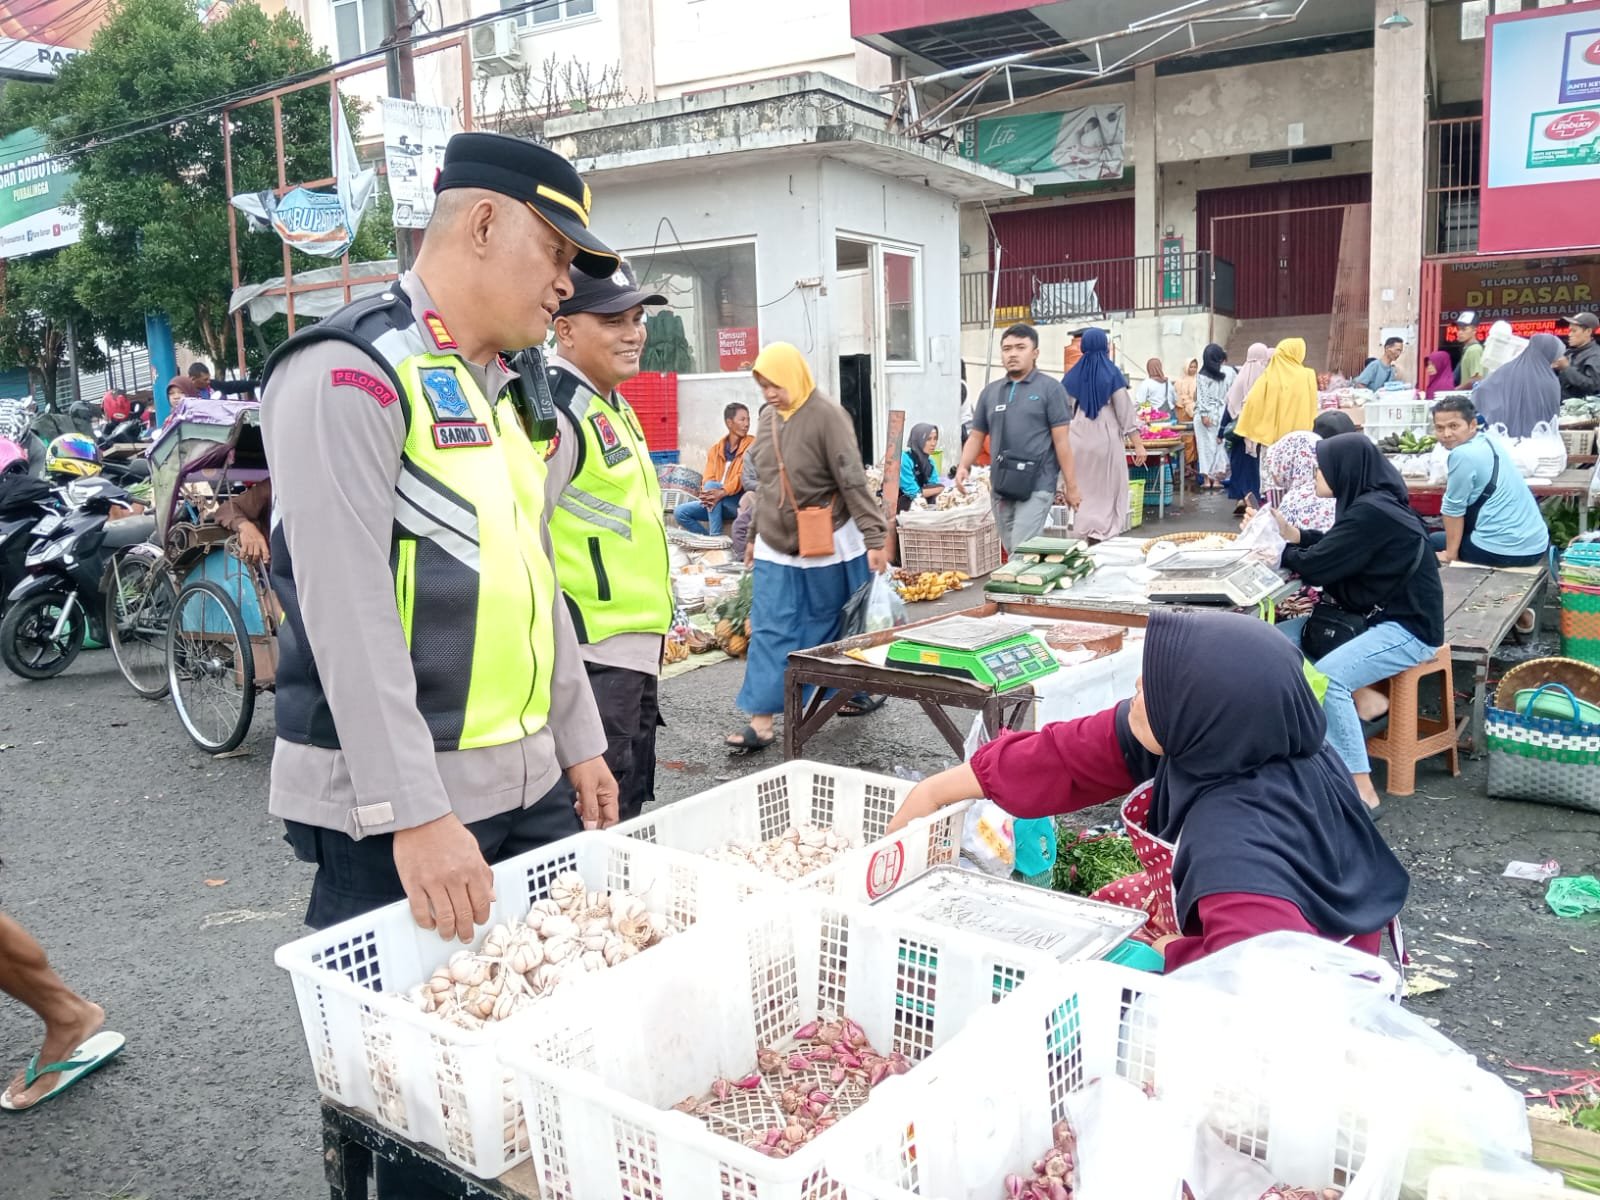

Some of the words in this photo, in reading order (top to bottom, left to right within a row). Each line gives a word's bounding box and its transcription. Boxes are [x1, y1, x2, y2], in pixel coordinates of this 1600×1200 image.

[1551, 119, 1595, 131] Lifebuoy
[1480, 277, 1530, 287] SELAMAT
[1533, 274, 1578, 284] DAYANG
[1467, 290, 1492, 307] DI
[1502, 285, 1591, 305] PASAR
[335, 371, 392, 404] PELOPOR
[440, 428, 476, 443] SARNO
[480, 428, 487, 442] U
